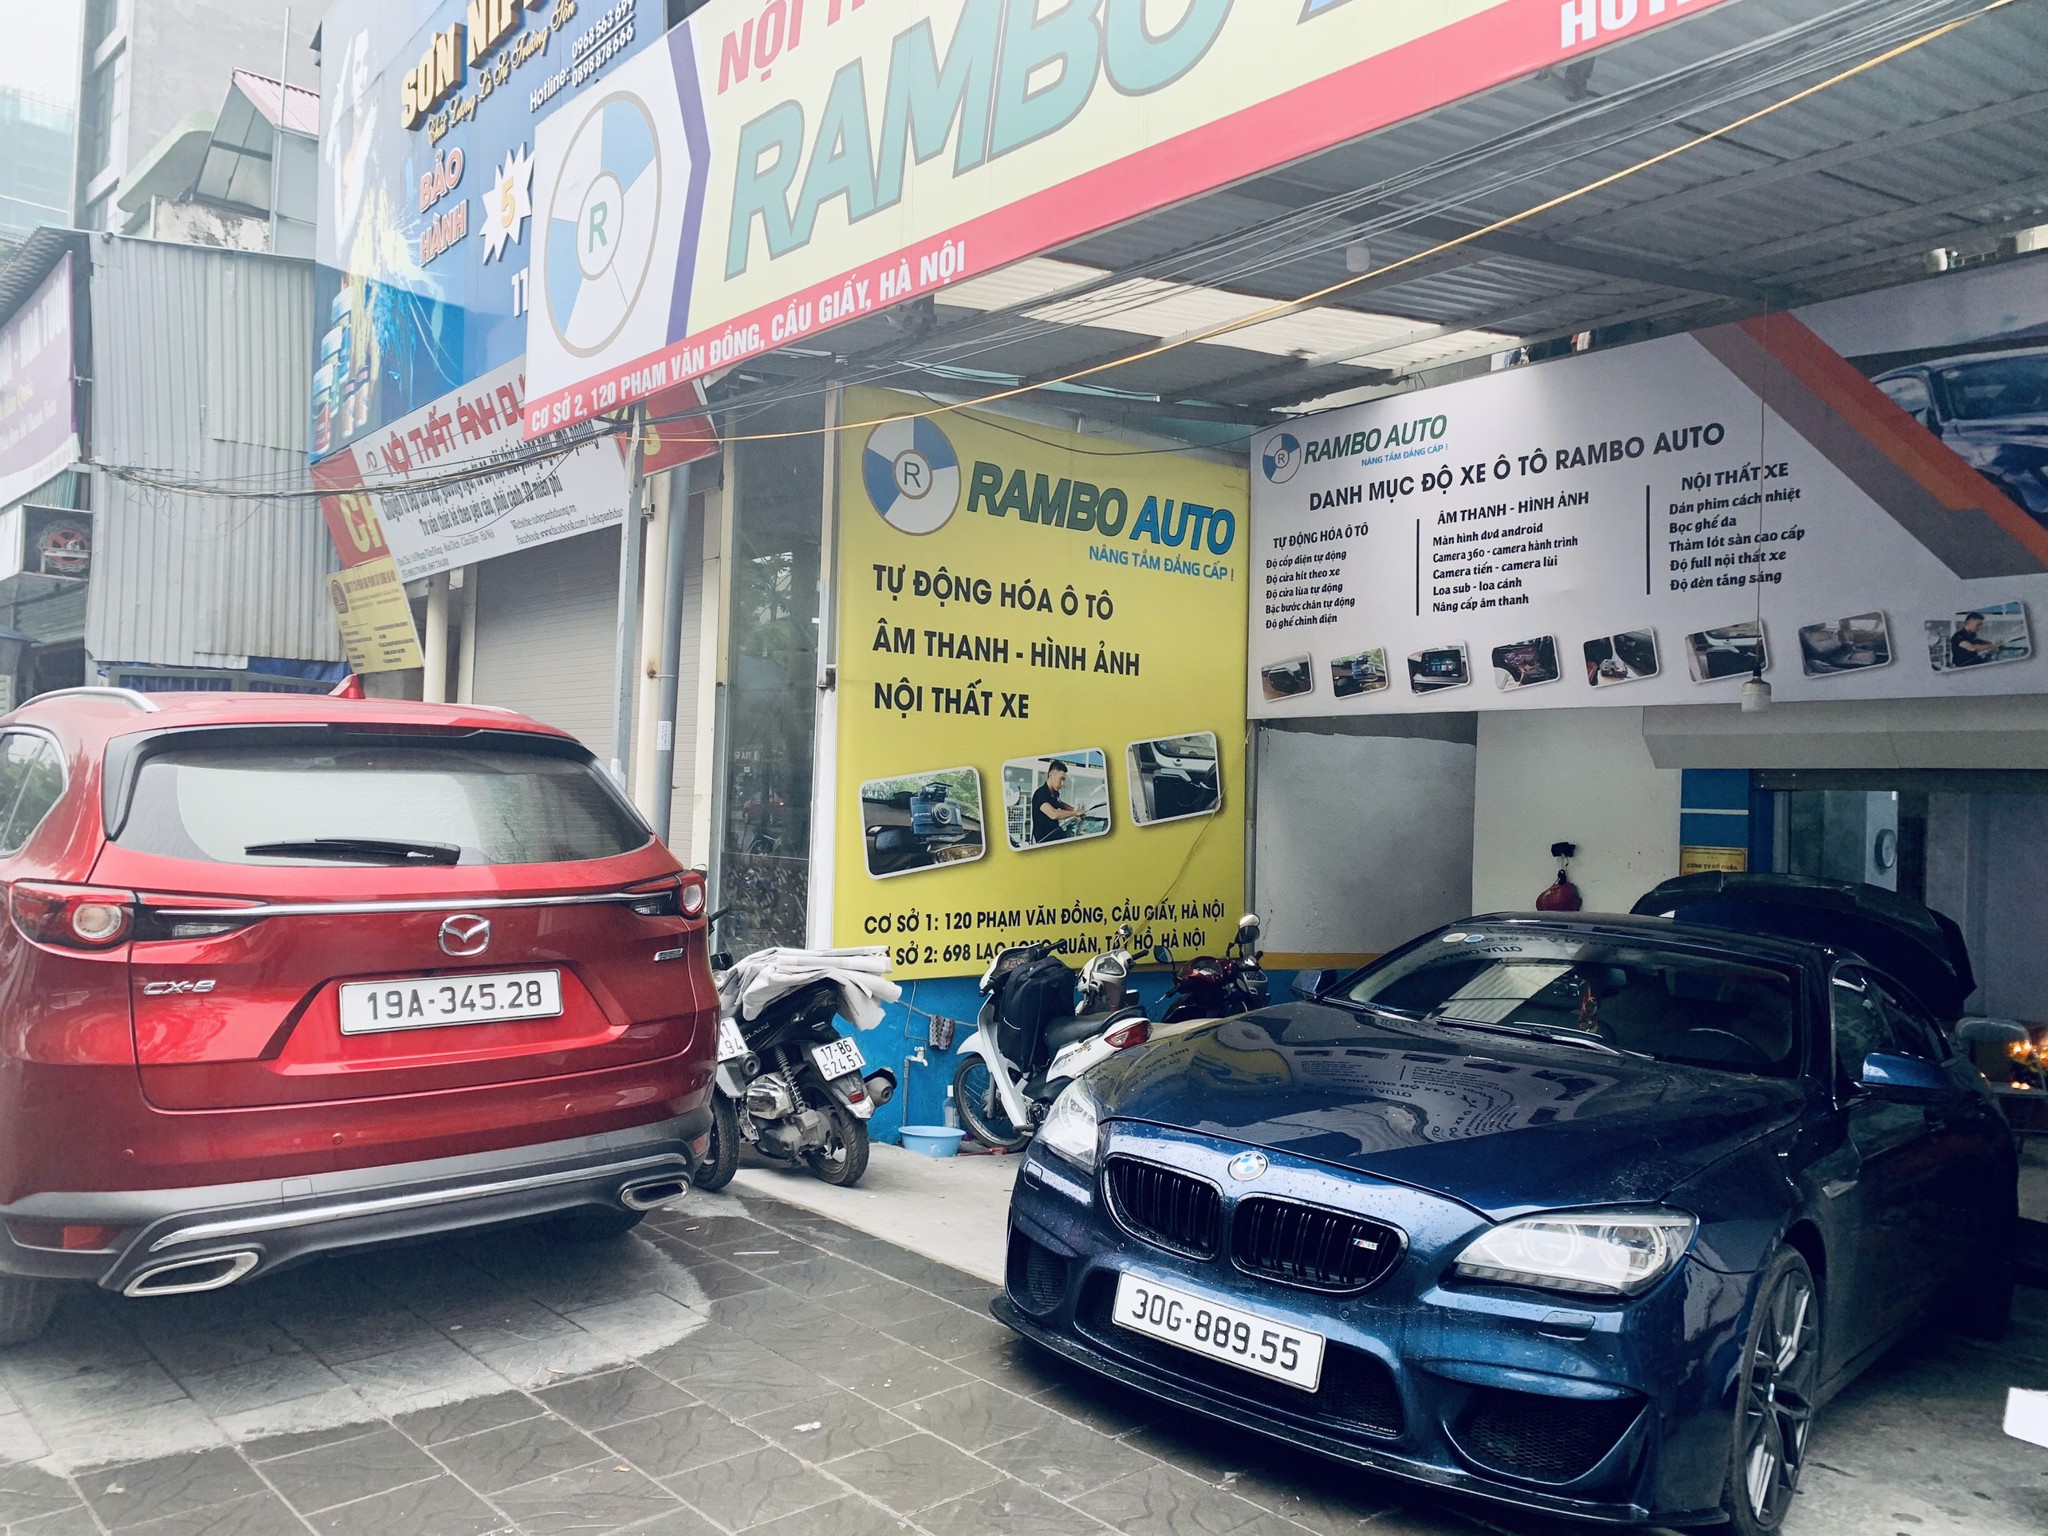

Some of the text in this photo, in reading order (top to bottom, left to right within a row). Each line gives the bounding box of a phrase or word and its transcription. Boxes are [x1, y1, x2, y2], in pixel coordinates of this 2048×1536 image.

[401, 22, 460, 130] SƠN
[530, 69, 572, 112] Hotline:
[421, 147, 464, 213] BẢO
[421, 199, 468, 268] HÀNH
[588, 201, 608, 255] R
[531, 404, 550, 432] CƠ
[552, 392, 572, 424] SỞ
[591, 381, 616, 410] 120
[621, 361, 667, 398] PHẠM
[671, 346, 705, 381] VĂN
[709, 324, 765, 366] ĐỒNG,
[771, 297, 812, 343] CẦU
[818, 274, 873, 324] GIẤY,
[880, 258, 912, 302] HÀ
[920, 240, 966, 289] NỘI
[380, 430, 414, 480] NỘI
[407, 405, 457, 465] THẤT
[456, 392, 502, 446] ÁNH
[1304, 414, 1448, 465] RAMBO AUTO
[904, 461, 921, 488] R
[1309, 422, 1726, 511] DANH MỤC ĐỘ XE Ô TÔ RAMBO AUTO
[1681, 461, 1789, 492] NỘI THẤT XE
[967, 460, 1236, 555] RAMBO AUTO
[1437, 490, 1590, 526] ÂM THANH HÌNH ẢNH
[1669, 487, 1802, 515] Dán phim cách nhiệt
[1272, 521, 1369, 550] TỰ ĐỘNG HÓA Ô TÔ
[1432, 522, 1544, 547] Màn hình dvd android
[1669, 514, 1737, 535] Bọc ghế da
[1669, 524, 1806, 552] Thảm lót sàn cao cấp
[1088, 545, 1129, 566] NÂNG
[1202, 559, 1228, 580] CẤP
[1294, 550, 1347, 566] điện động
[1432, 551, 1467, 563] Camera
[1467, 549, 1485, 562] 360
[1492, 543, 1527, 556] camera
[1553, 535, 1579, 549] trình
[1669, 548, 1787, 573] Độ full nội thất xe
[1308, 568, 1328, 580] theo
[1432, 555, 1558, 580] Camera tiến camera lùi
[1669, 570, 1783, 592] Độ đèn tăng sáng
[872, 564, 1114, 621] TỰ ĐỘNG HÓA Ô TÔ
[1321, 582, 1343, 595] động
[1432, 576, 1523, 596] Loa sub loa cánh
[1281, 597, 1356, 613] bước động
[1318, 612, 1338, 625] điện
[1432, 593, 1530, 613] Nâng cấp âm thanh
[872, 617, 1141, 677] ÂM THANH HÌNH ẢNH
[874, 677, 1030, 719] NỘI THẤT XE
[863, 896, 1225, 935] CƠ SỞ 120 PHẠM VĂN ĐỒNG, CẦU GIẤY, HÀ NỘI
[896, 940, 919, 966] SỞ
[942, 944, 971, 962] 698
[1161, 934, 1179, 948] HÀ
[1183, 931, 1206, 950] NỘI
[143, 979, 216, 996] CX-8
[366, 979, 544, 1022] 19A-345.28
[822, 1052, 863, 1077] 524.51
[1131, 1288, 1301, 1371] 30G-889.55
